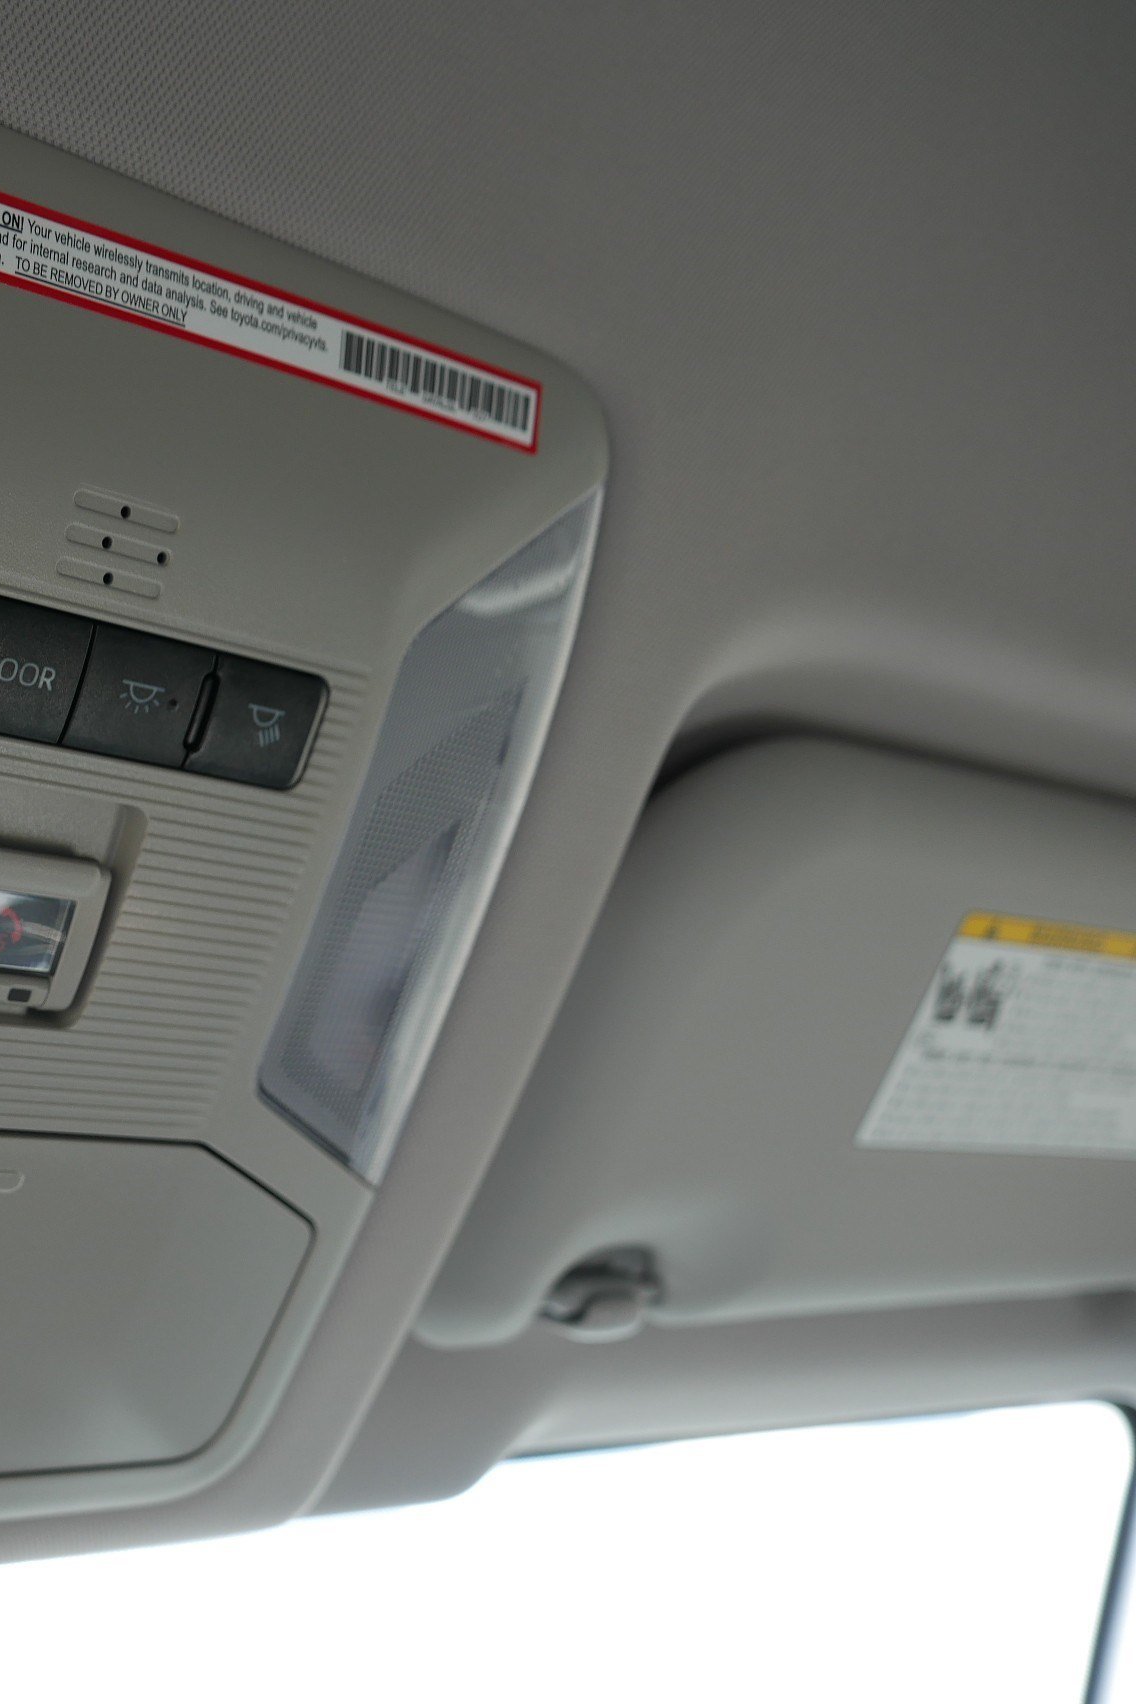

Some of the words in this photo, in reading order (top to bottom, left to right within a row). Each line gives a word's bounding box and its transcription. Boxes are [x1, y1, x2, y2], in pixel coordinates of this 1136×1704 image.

[1, 211, 24, 231] ON!
[27, 218, 52, 239] Your
[55, 232, 91, 253] vehicle
[94, 244, 143, 273] wirelessly
[146, 260, 189, 286] transmits
[192, 274, 231, 302] location,
[234, 291, 264, 315] driving
[267, 303, 284, 319] and
[287, 310, 318, 330] vehicle
[12, 234, 27, 252] for
[30, 239, 69, 265] internal
[72, 256, 117, 281] research
[120, 273, 138, 287] and
[141, 280, 163, 296] data
[165, 286, 207, 311] analysis.
[210, 300, 228, 319] See
[15, 256, 31, 272] TO
[33, 261, 48, 278] BE
[50, 267, 103, 295] REMOVED
[106, 285, 119, 300] BY
[121, 290, 160, 314] OWNER
[162, 304, 187, 322] ONLY
